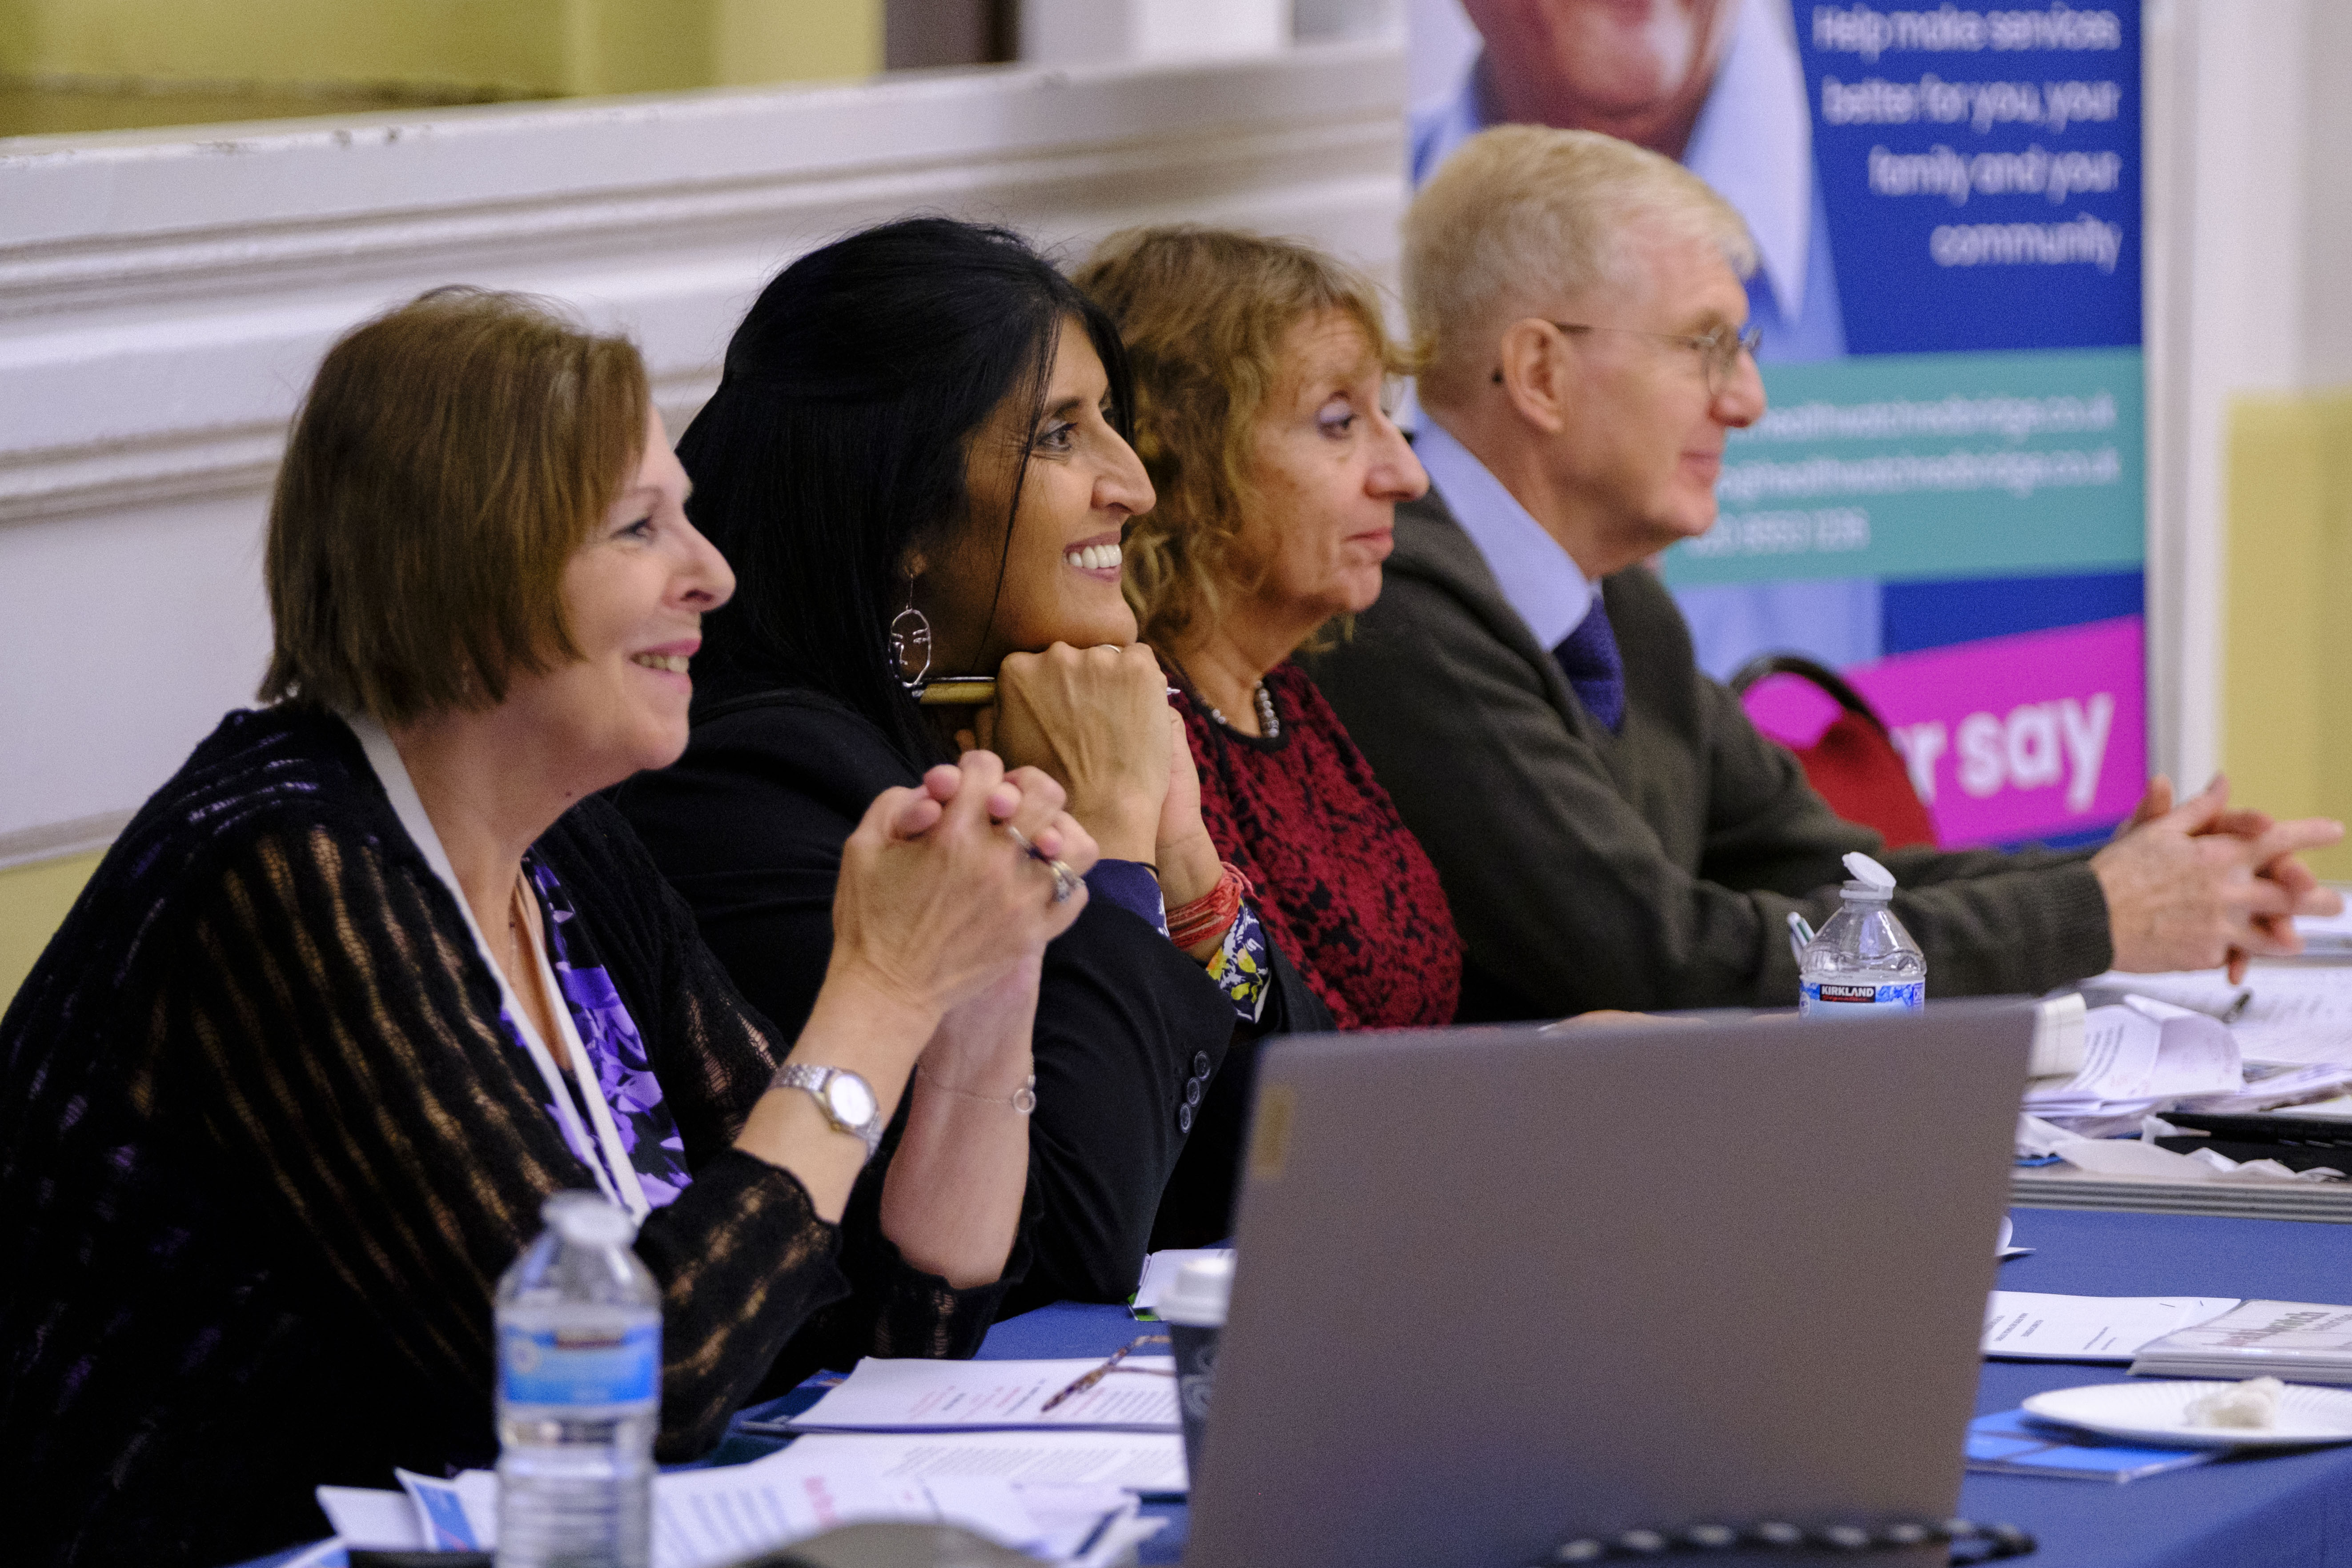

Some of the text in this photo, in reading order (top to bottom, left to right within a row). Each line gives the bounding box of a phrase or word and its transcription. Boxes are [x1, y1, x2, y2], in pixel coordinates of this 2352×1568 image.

[1815, 4, 2119, 61] Help make services
[1823, 76, 1921, 124] better
[1922, 75, 1970, 123] for
[2045, 81, 2119, 132] your
[1869, 145, 2119, 205] family and your
[1931, 214, 2120, 271] community
[1957, 693, 2115, 814] say
[1822, 985, 1874, 998] KIRKLAND
